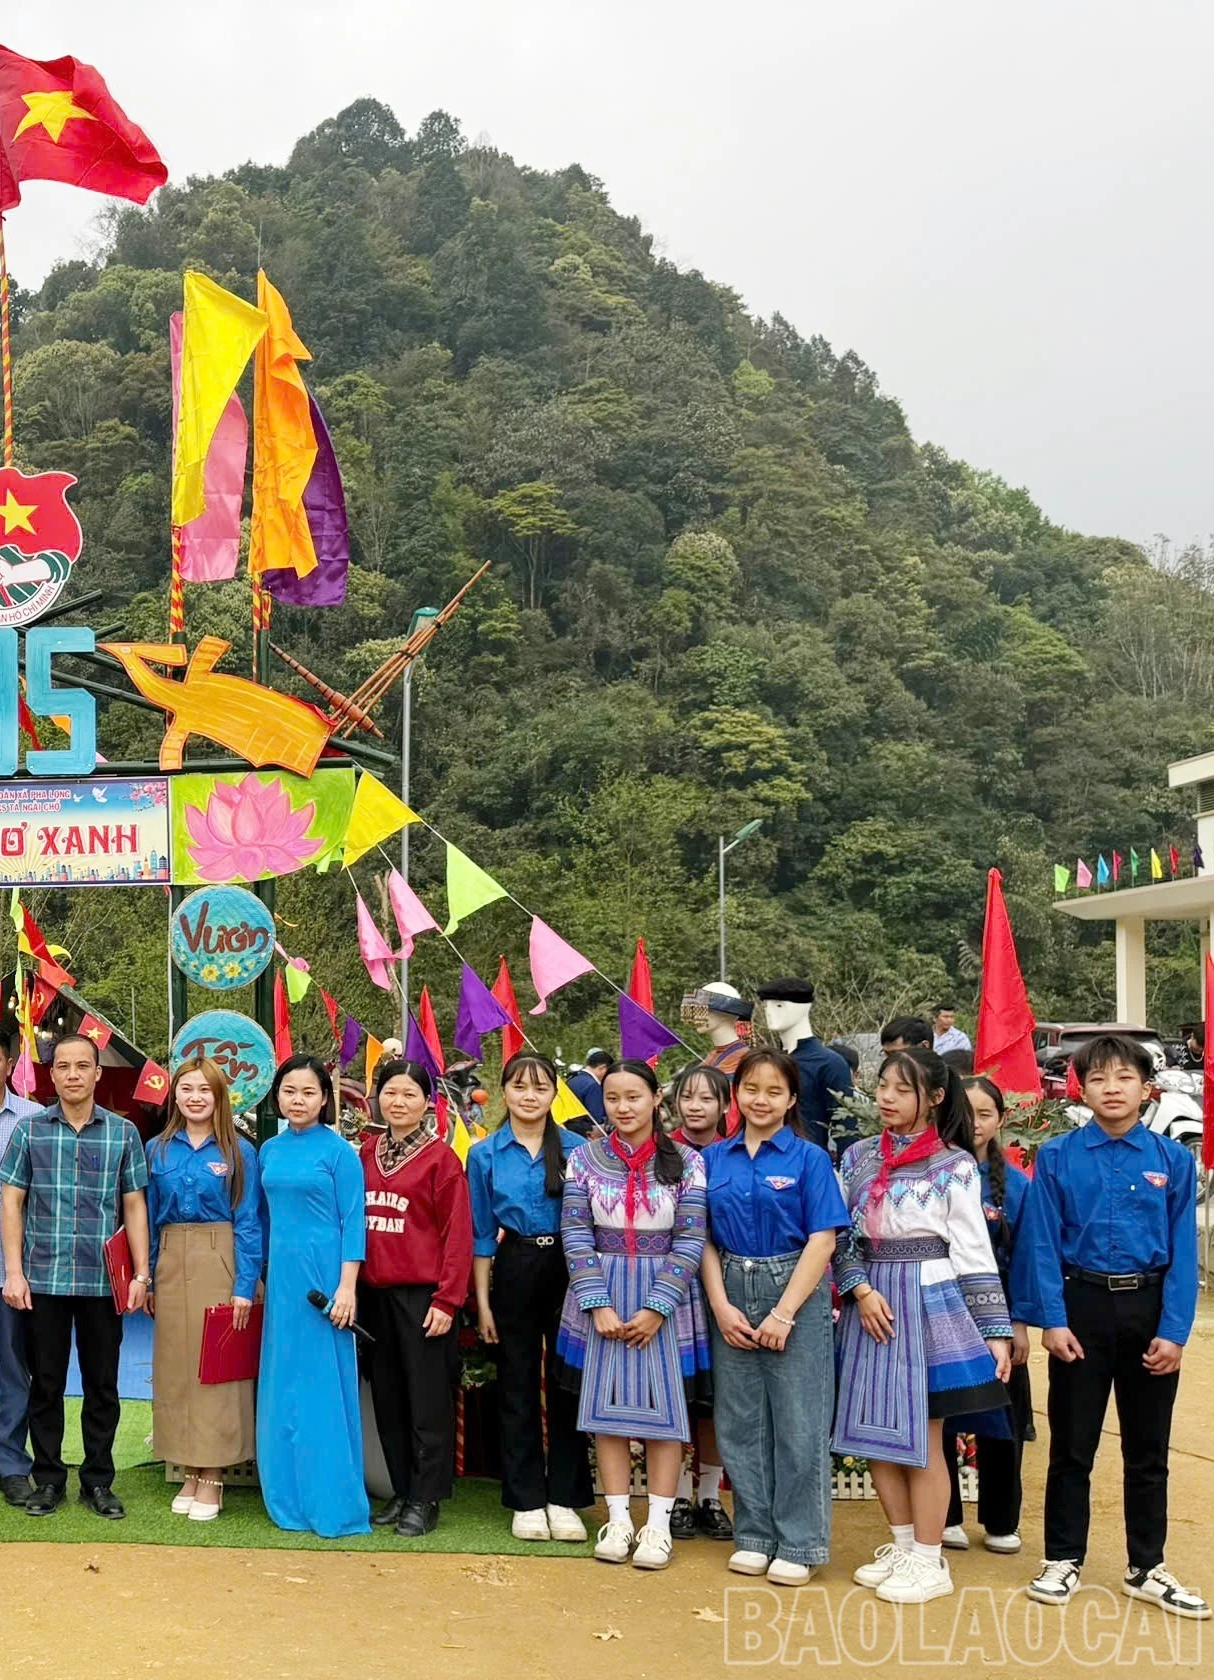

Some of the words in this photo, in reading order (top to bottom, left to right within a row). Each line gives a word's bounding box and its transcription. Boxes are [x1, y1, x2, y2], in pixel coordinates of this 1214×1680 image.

[36, 586, 55, 607] MINH
[17, 789, 28, 800] XÃ
[30, 790, 47, 799] PHA
[49, 789, 71, 799] LONG
[37, 824, 137, 855] XANH
[180, 901, 270, 954] Vươn
